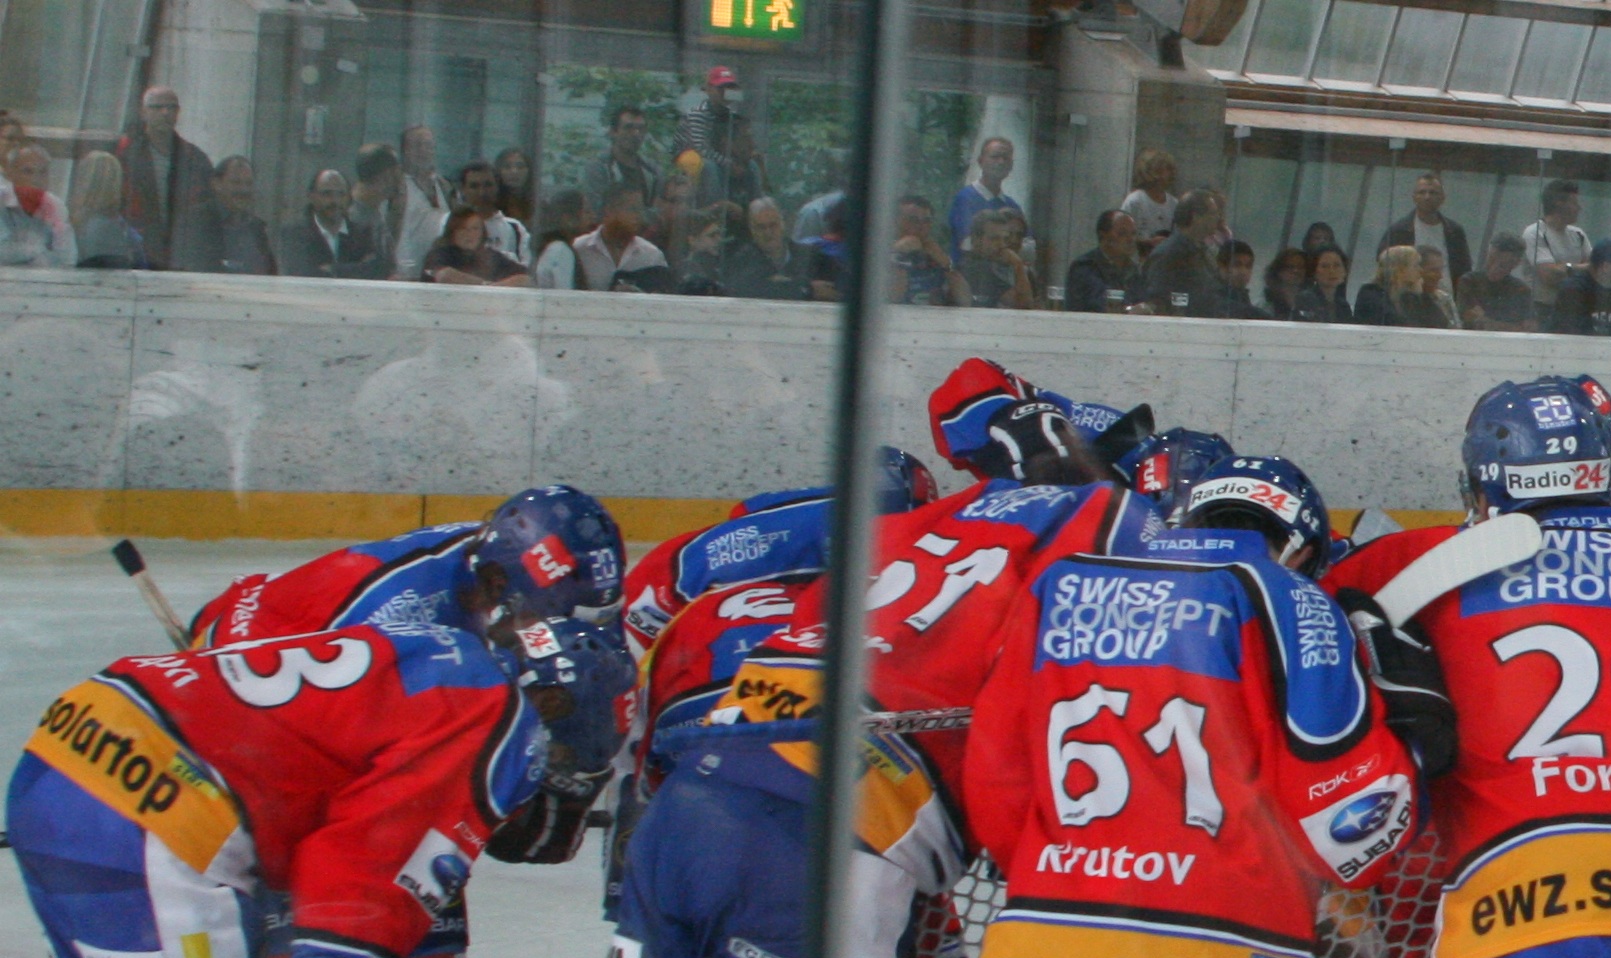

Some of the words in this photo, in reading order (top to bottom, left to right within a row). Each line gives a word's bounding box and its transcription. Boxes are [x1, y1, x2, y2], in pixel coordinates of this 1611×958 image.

[1546, 436, 1577, 455] 29
[1144, 457, 1162, 491] ruf
[1232, 458, 1264, 470] 61
[1479, 462, 1500, 481] 29
[1508, 469, 1571, 491] Radio
[1572, 463, 1605, 491] 24
[1191, 483, 1249, 504] Radio
[1248, 484, 1290, 512] 24
[705, 525, 760, 553] SWISS
[1148, 539, 1236, 551] STADLER
[530, 543, 572, 581] ruf
[709, 544, 771, 571] GROUP
[1055, 573, 1175, 607] SWISS
[1050, 598, 1233, 637] CONCEPT
[1043, 624, 1169, 661] GROUP
[1047, 683, 1224, 839] 61
[1036, 841, 1196, 885] Krutov
